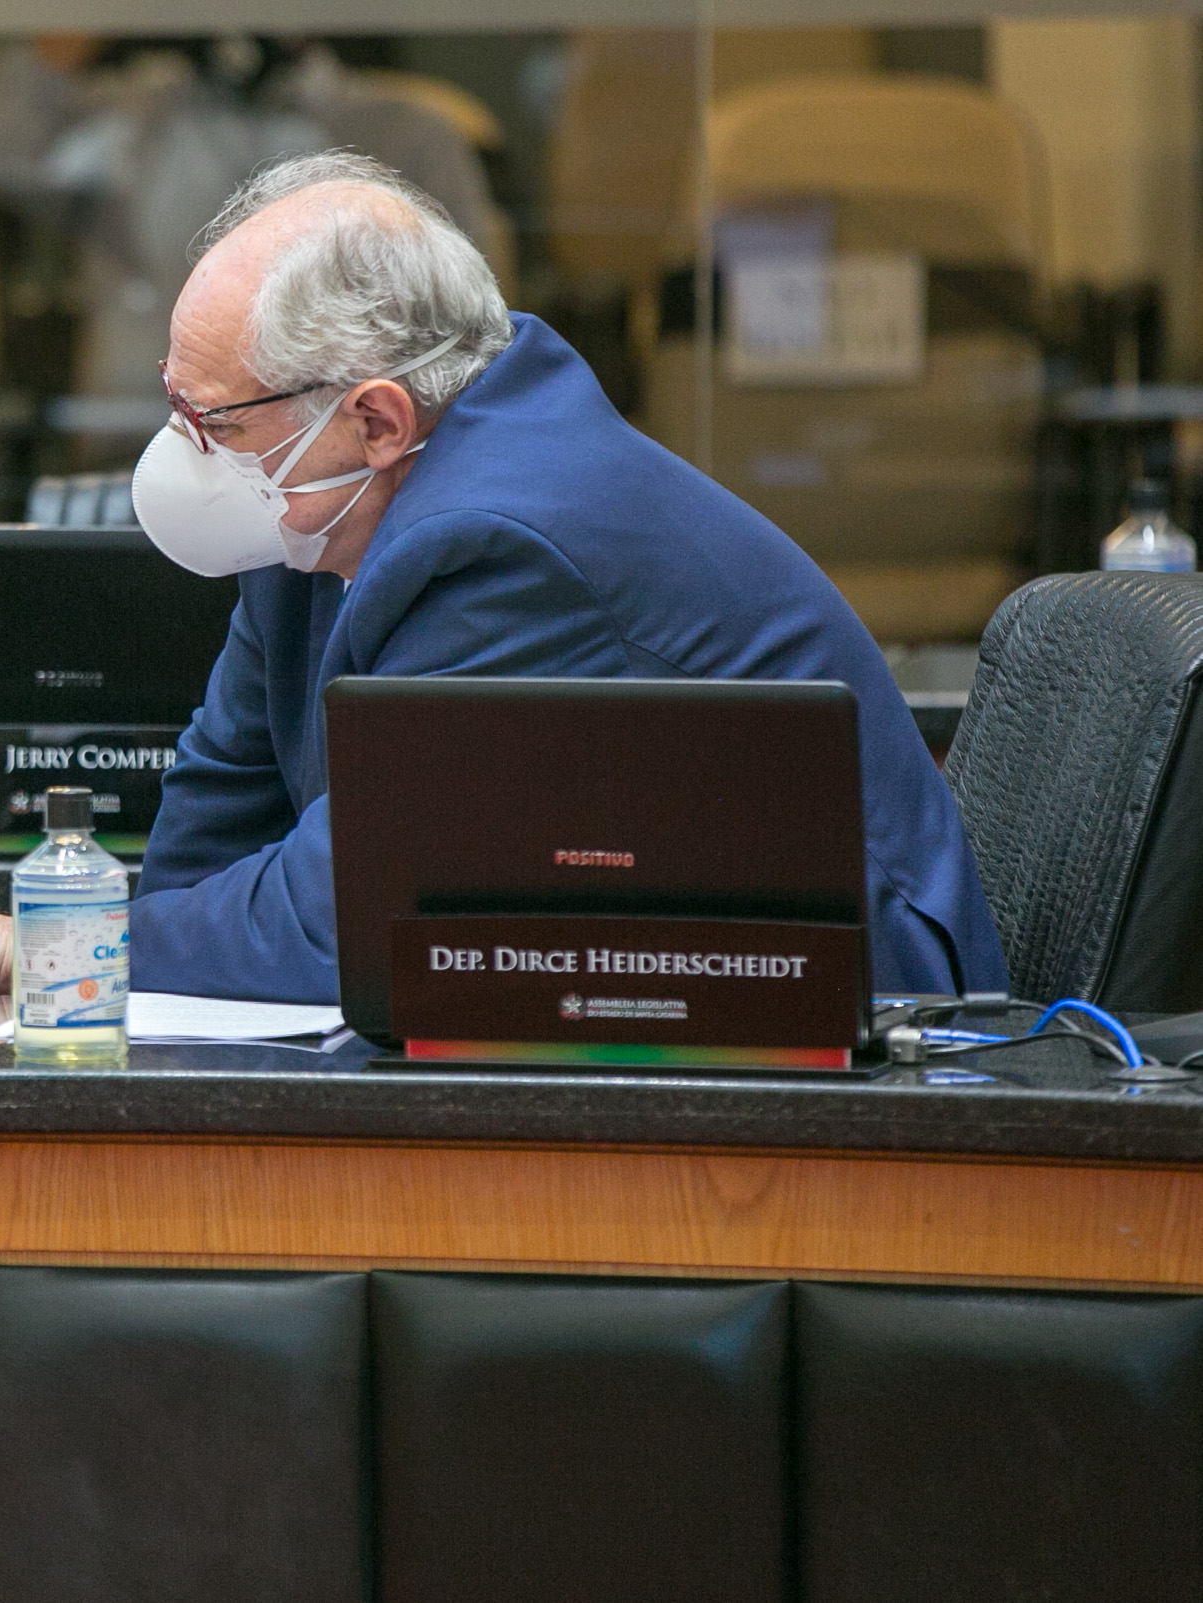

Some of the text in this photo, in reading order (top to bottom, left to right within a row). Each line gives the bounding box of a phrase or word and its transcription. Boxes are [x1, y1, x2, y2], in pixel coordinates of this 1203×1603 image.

[5, 744, 75, 774] JERRY
[554, 850, 635, 868] POSITIVO
[429, 945, 808, 978] DEP. DIRCE HEIDERSCHEIDT
